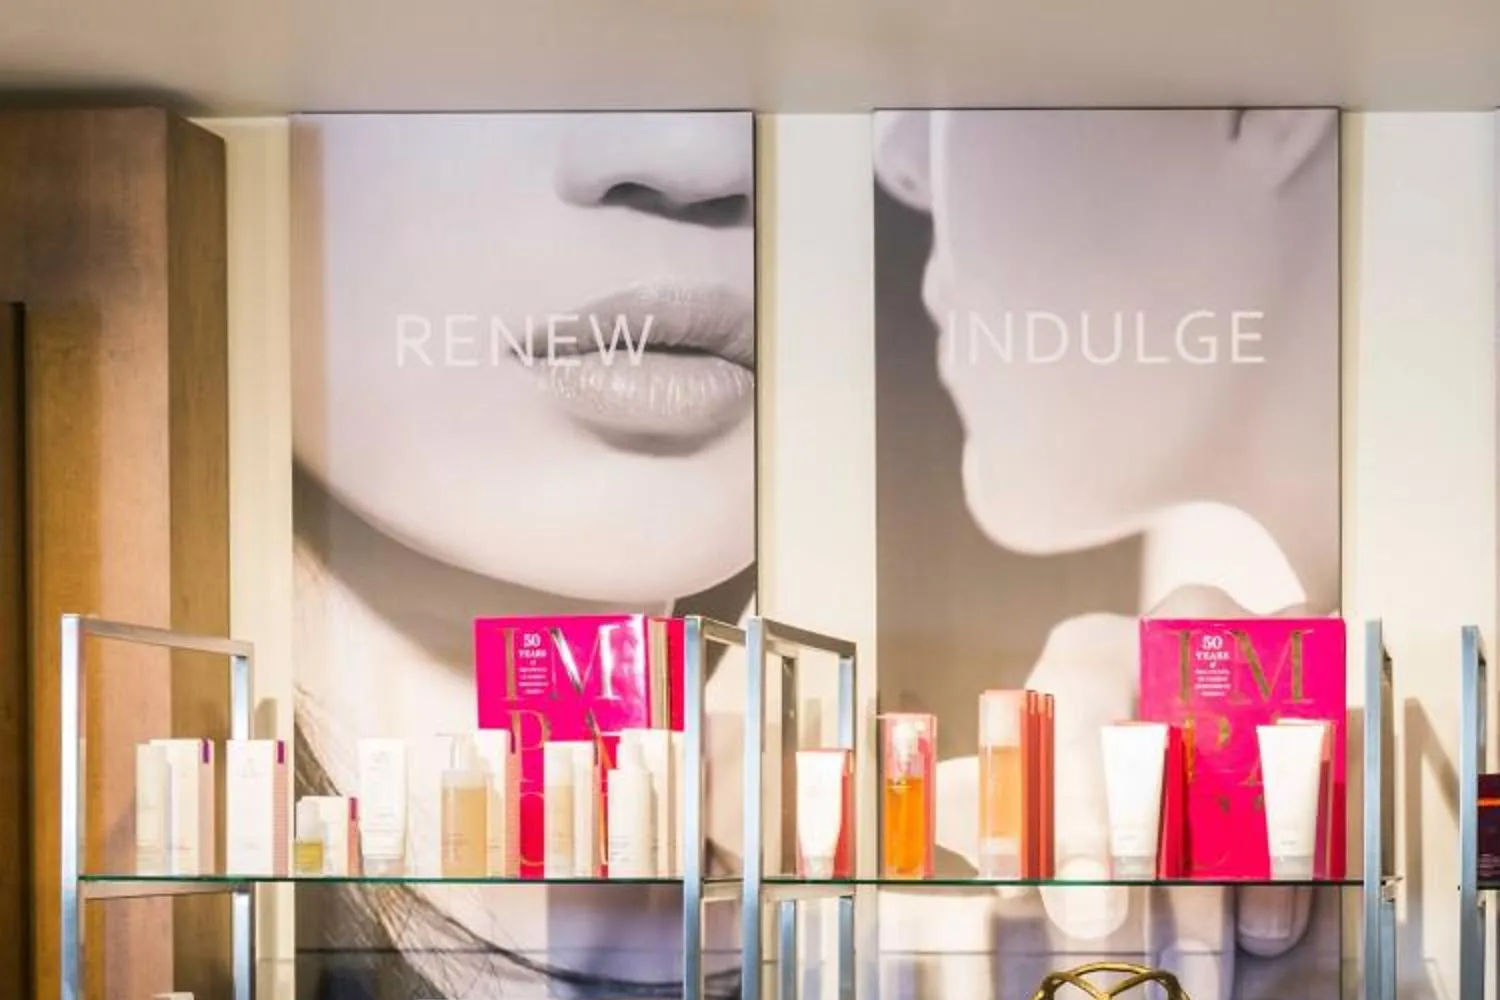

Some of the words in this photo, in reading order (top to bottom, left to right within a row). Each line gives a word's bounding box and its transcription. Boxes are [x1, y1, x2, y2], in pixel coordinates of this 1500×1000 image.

[395, 313, 655, 368] RENEW
[948, 310, 1266, 364] INDULGE
[523, 633, 541, 648] 50
[1202, 635, 1223, 649] 50
[1195, 651, 1230, 660] YEARS
